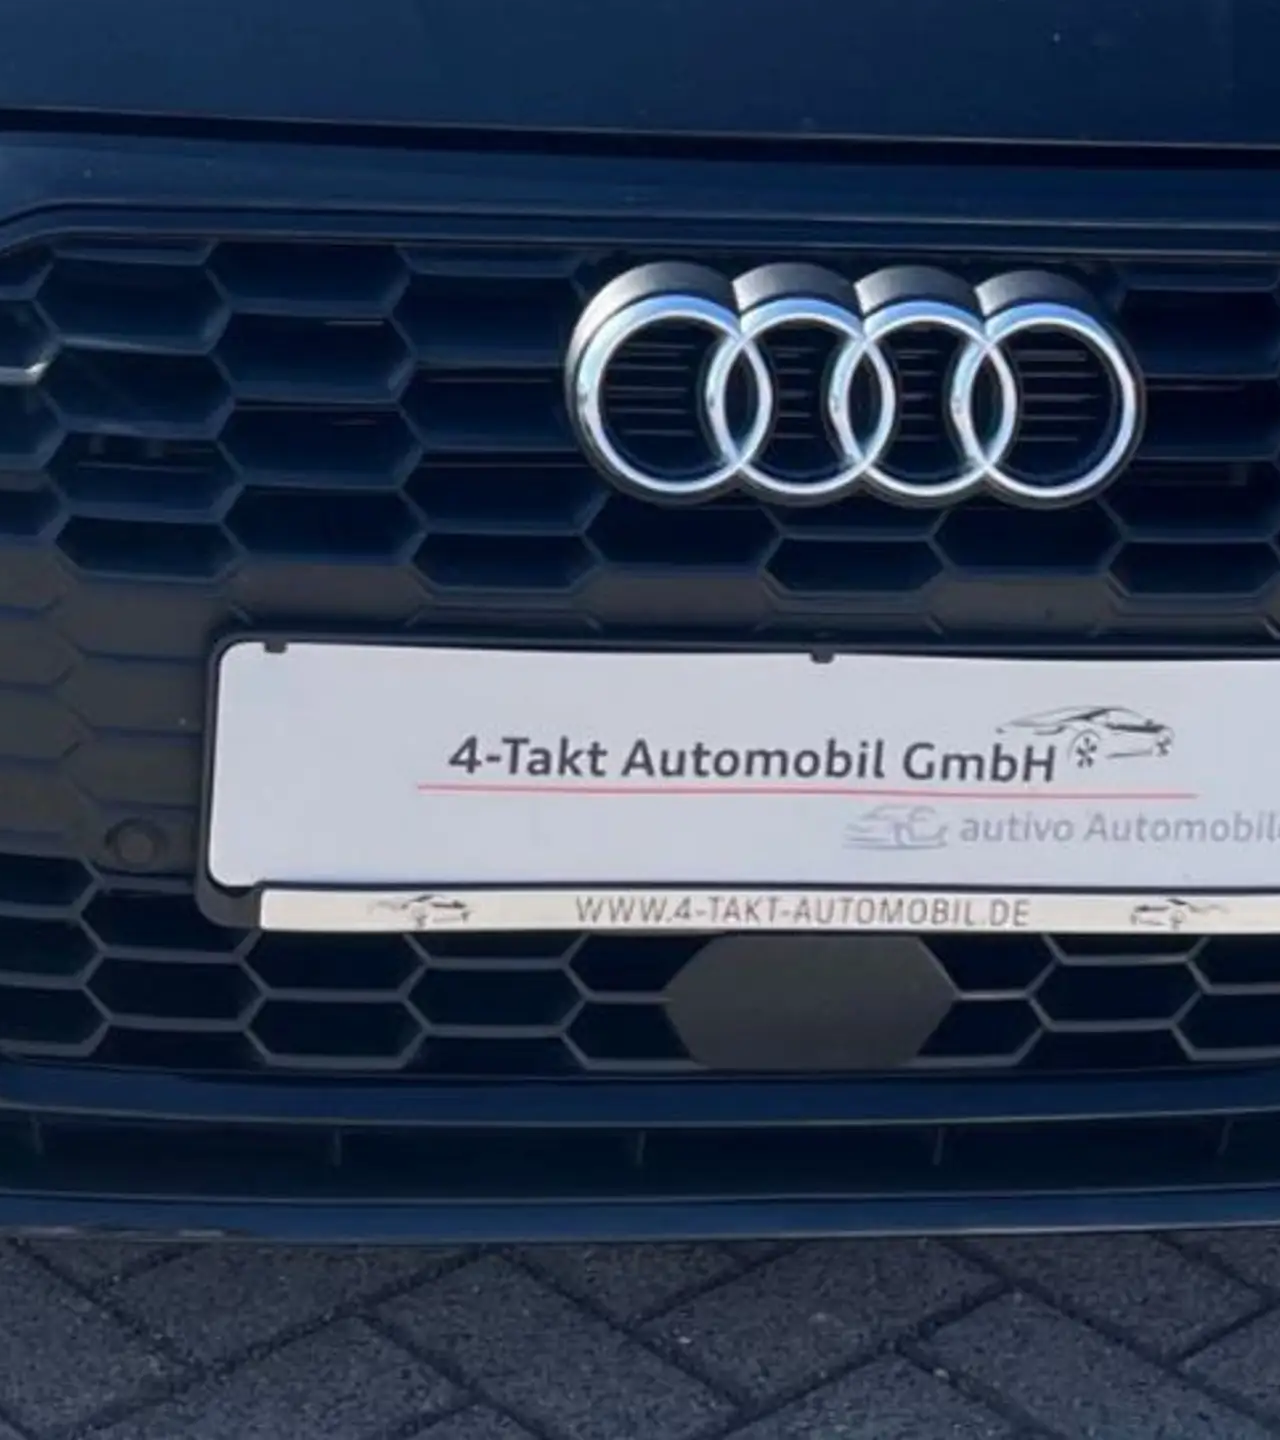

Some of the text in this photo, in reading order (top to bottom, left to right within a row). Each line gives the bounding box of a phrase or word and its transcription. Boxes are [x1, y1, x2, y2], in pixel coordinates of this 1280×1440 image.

[448, 735, 1056, 783] 4-Takt Automobil GmbH
[960, 816, 1074, 843] autivo
[575, 895, 1030, 928] WWW.4-TAKT-AUTOMOBIL.DE
